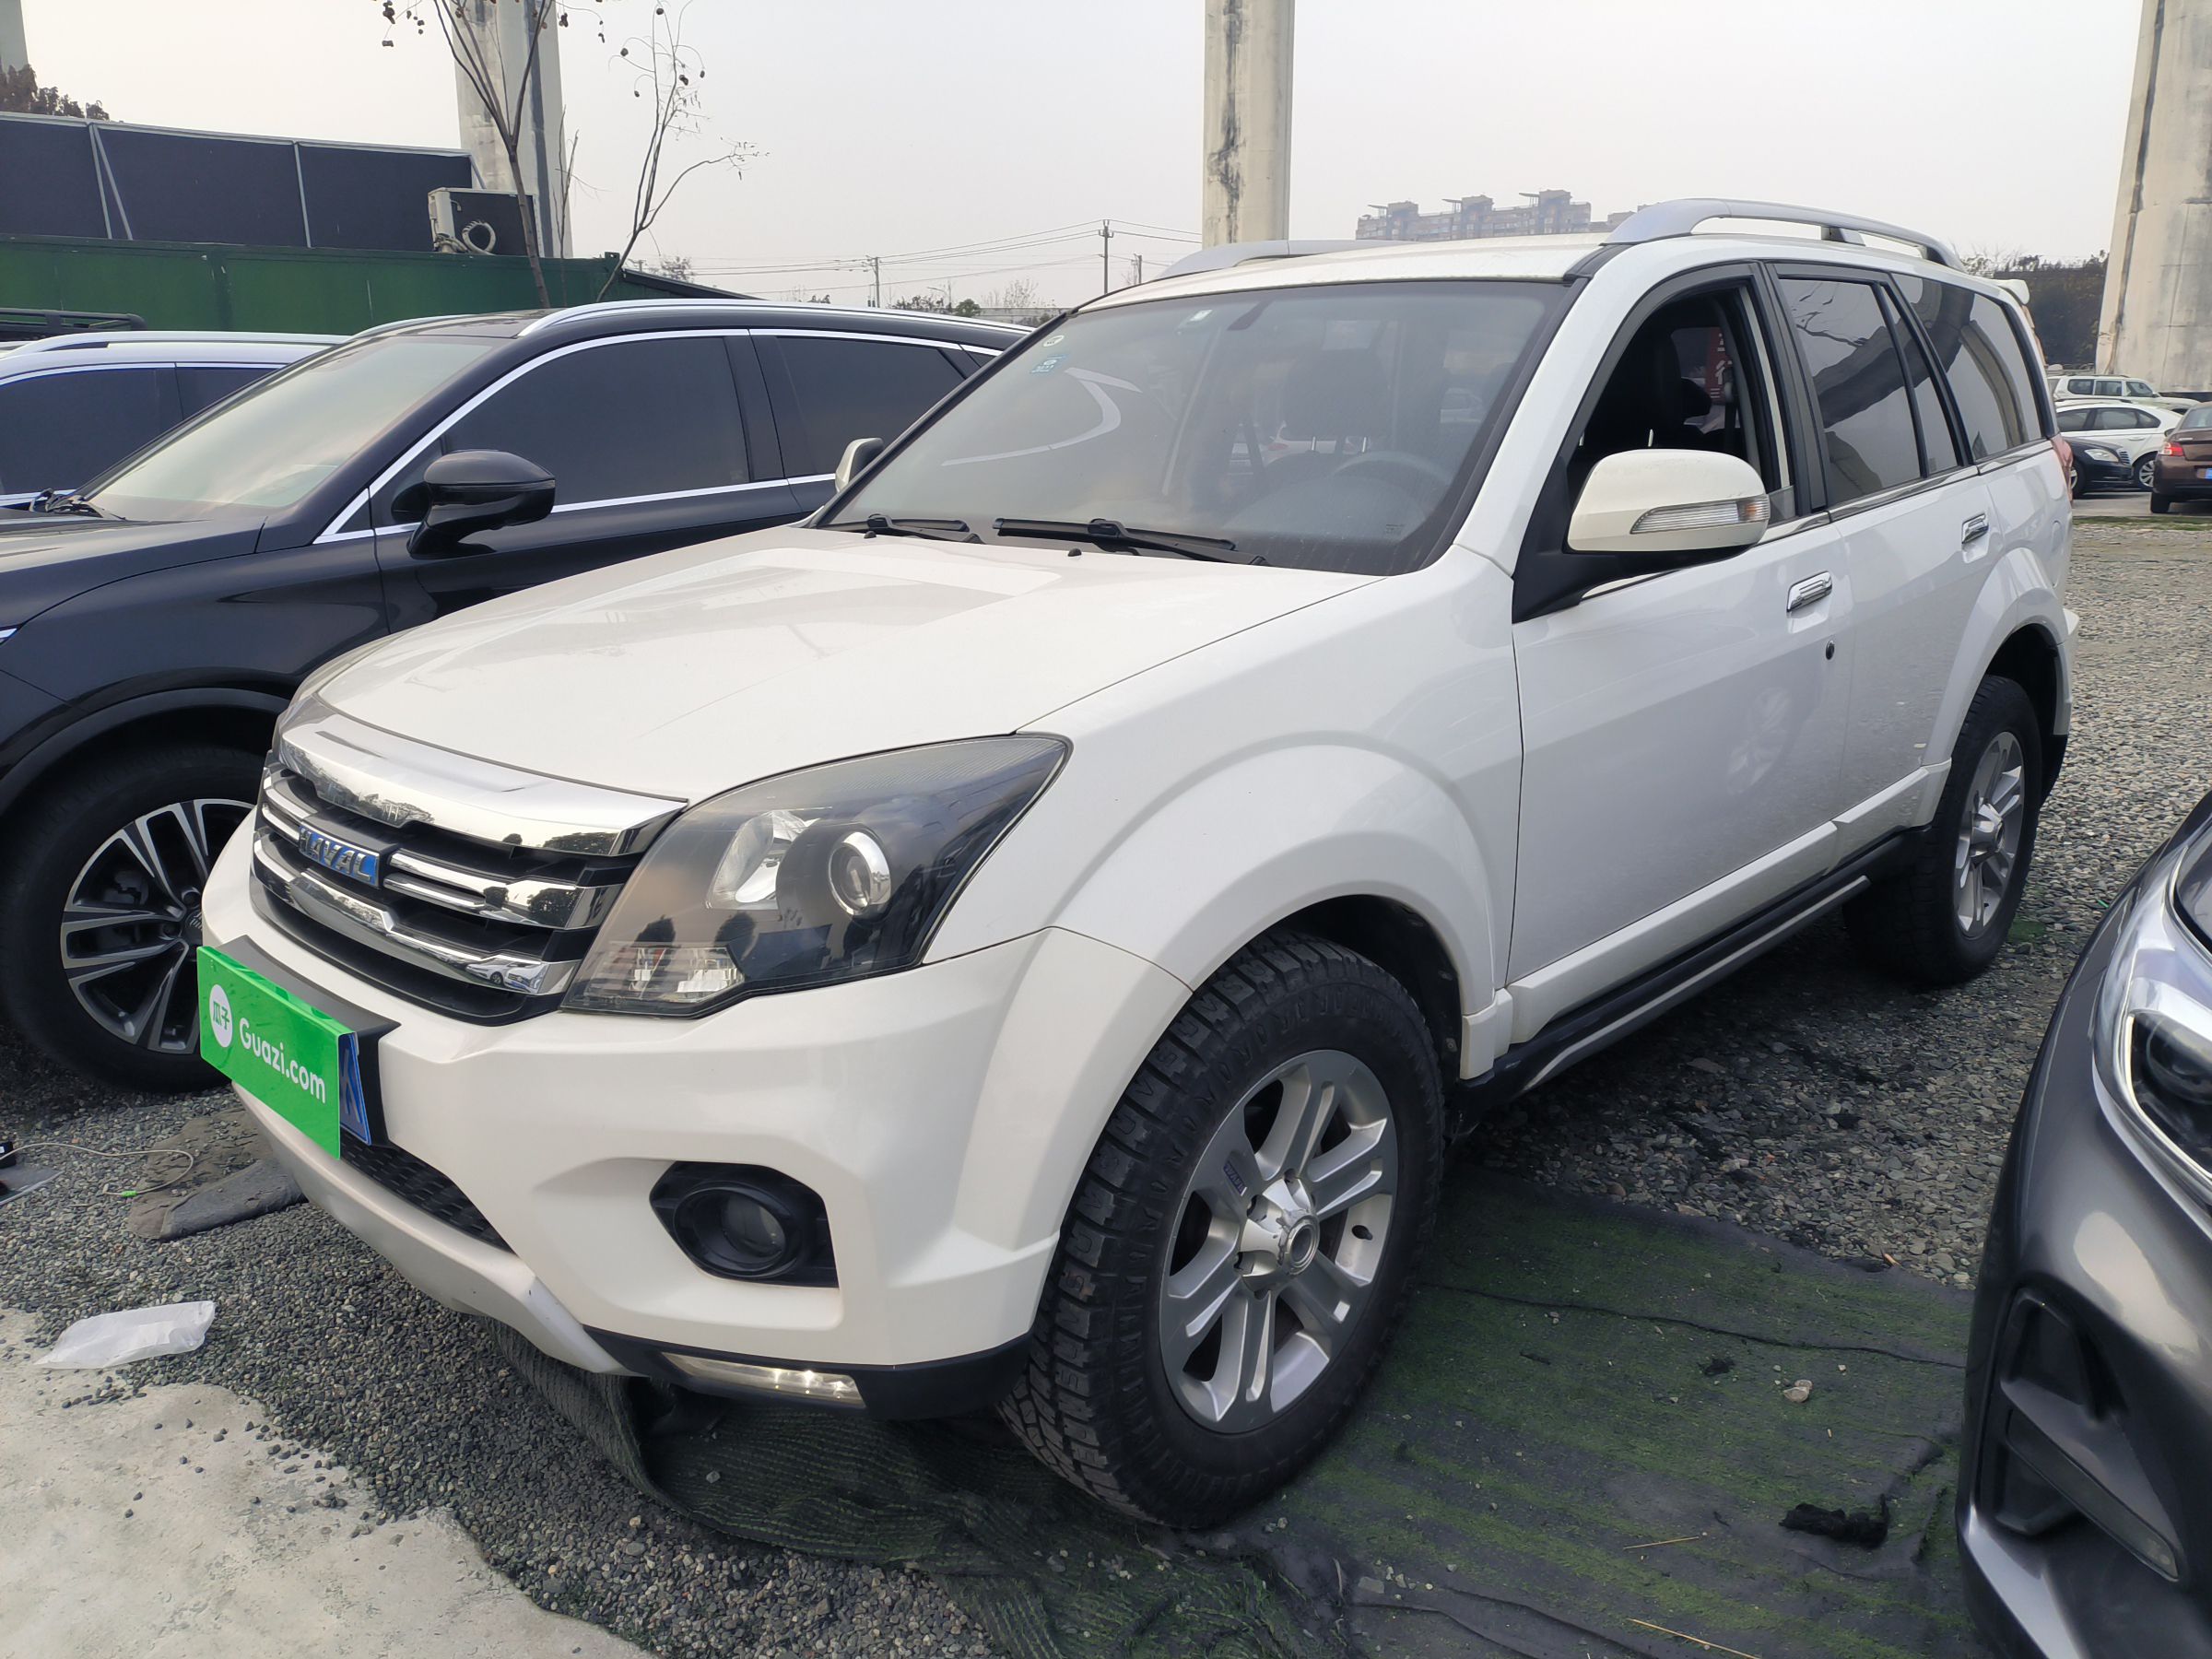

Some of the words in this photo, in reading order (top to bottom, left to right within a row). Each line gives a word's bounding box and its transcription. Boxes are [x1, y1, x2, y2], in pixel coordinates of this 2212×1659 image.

[299, 828, 371, 881] HAVAL
[212, 1000, 230, 1030] 瓜子
[239, 1018, 326, 1104] Guazi.com
